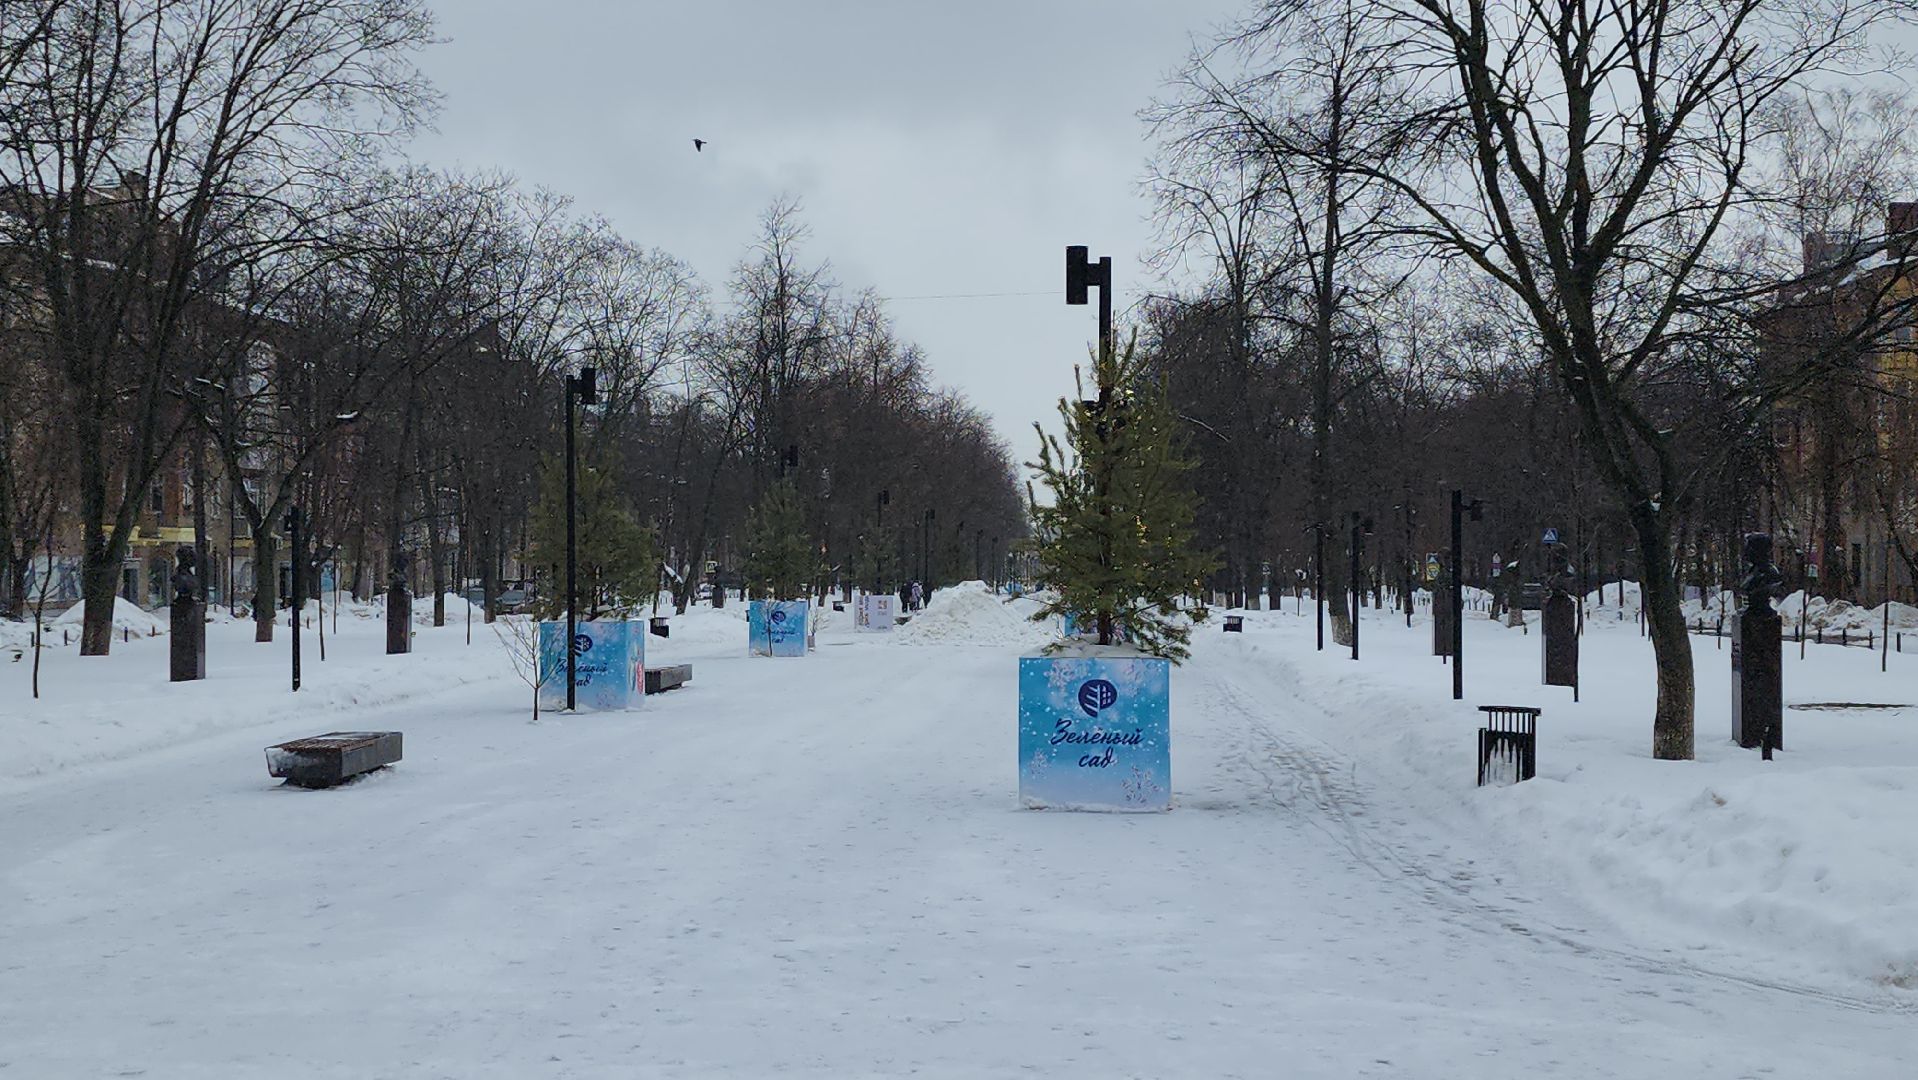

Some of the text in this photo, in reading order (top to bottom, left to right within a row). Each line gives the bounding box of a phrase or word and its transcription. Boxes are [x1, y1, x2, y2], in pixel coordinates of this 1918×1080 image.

[576, 674, 591, 687] ад
[1050, 718, 1144, 745] Зелёный
[1079, 746, 1114, 768] сад
